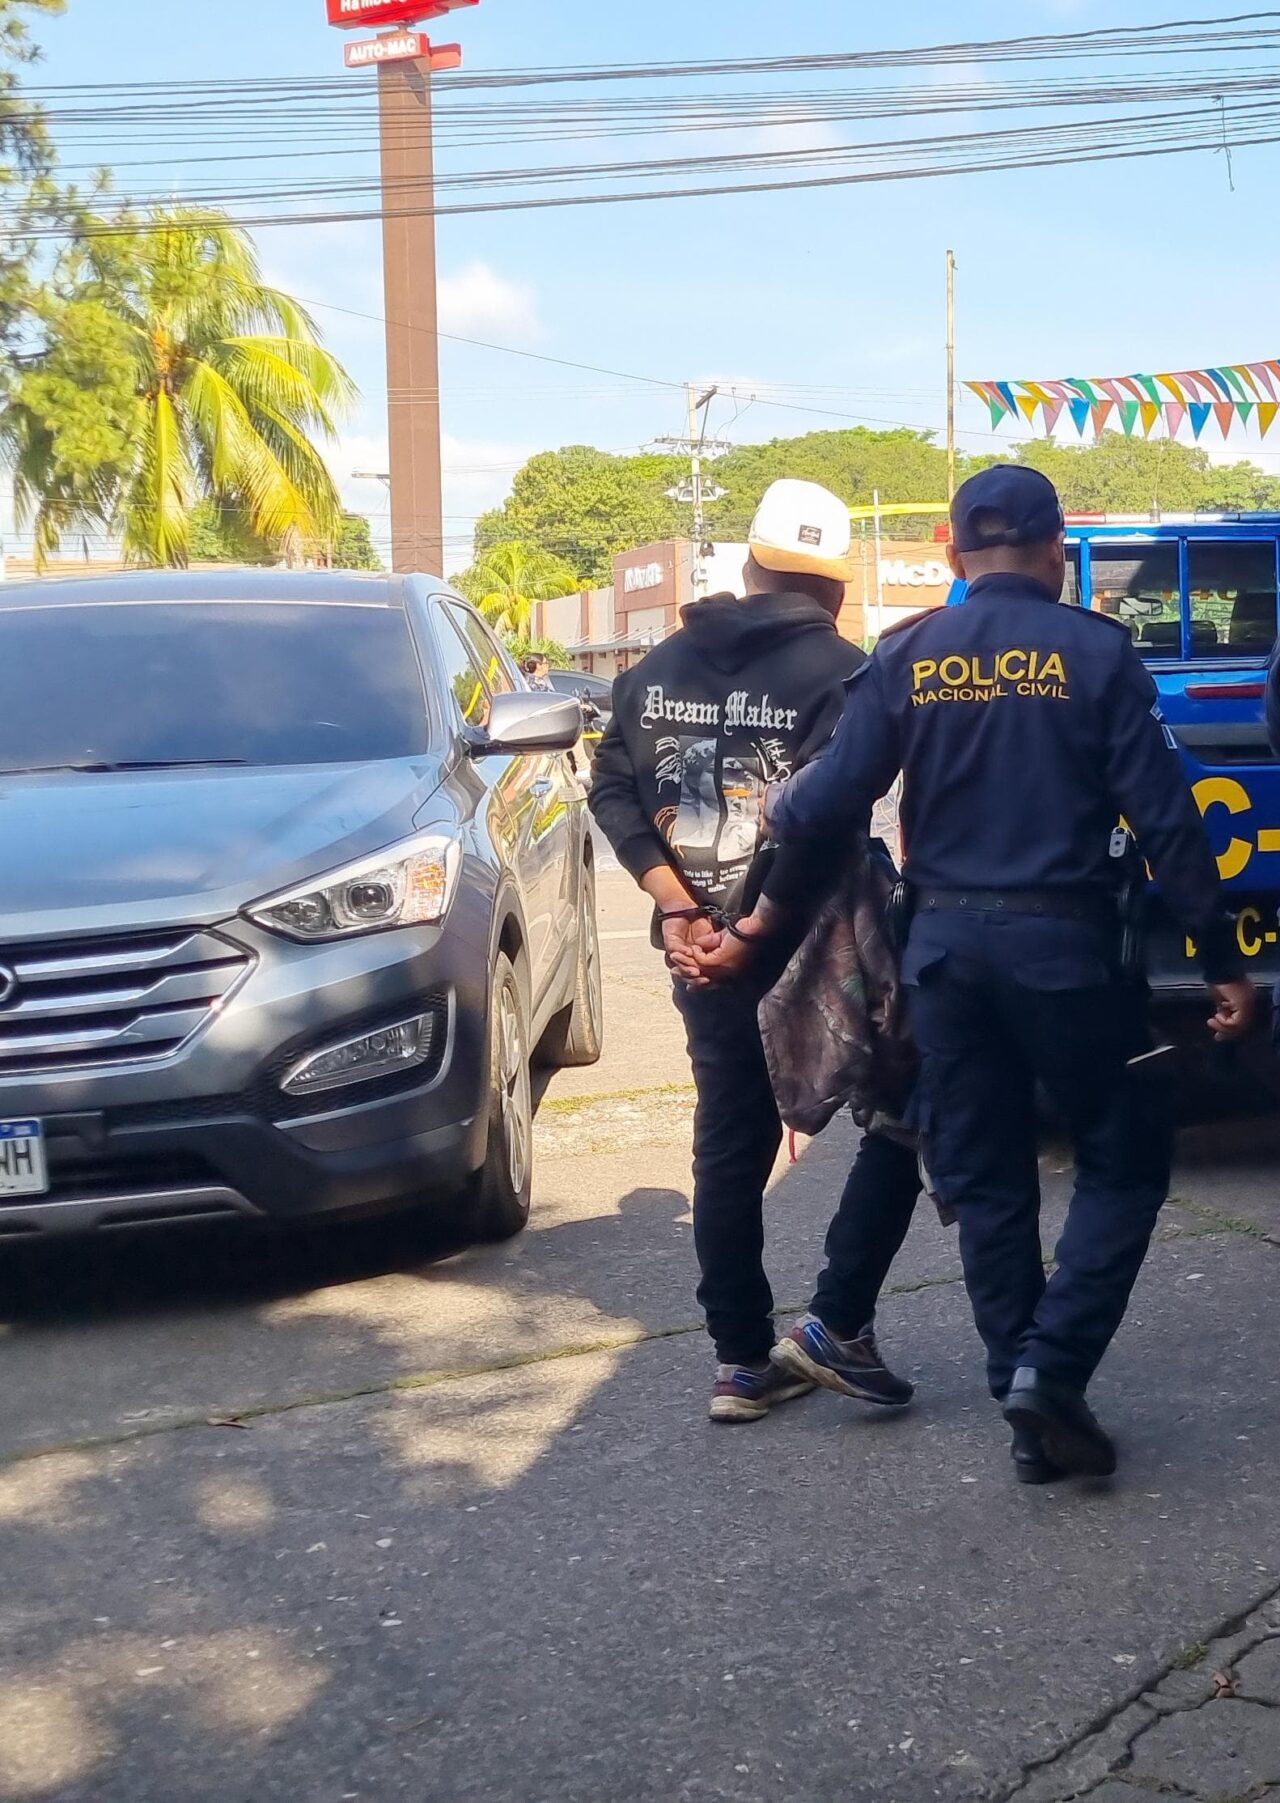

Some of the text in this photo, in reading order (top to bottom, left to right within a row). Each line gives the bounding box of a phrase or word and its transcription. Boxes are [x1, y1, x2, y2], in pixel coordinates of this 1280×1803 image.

[349, 38, 417, 62] AUTO-MAC
[912, 650, 1068, 690] POLICIA
[640, 685, 798, 736] Dream Maker
[911, 682, 1070, 707] NACIONAL CIVIL
